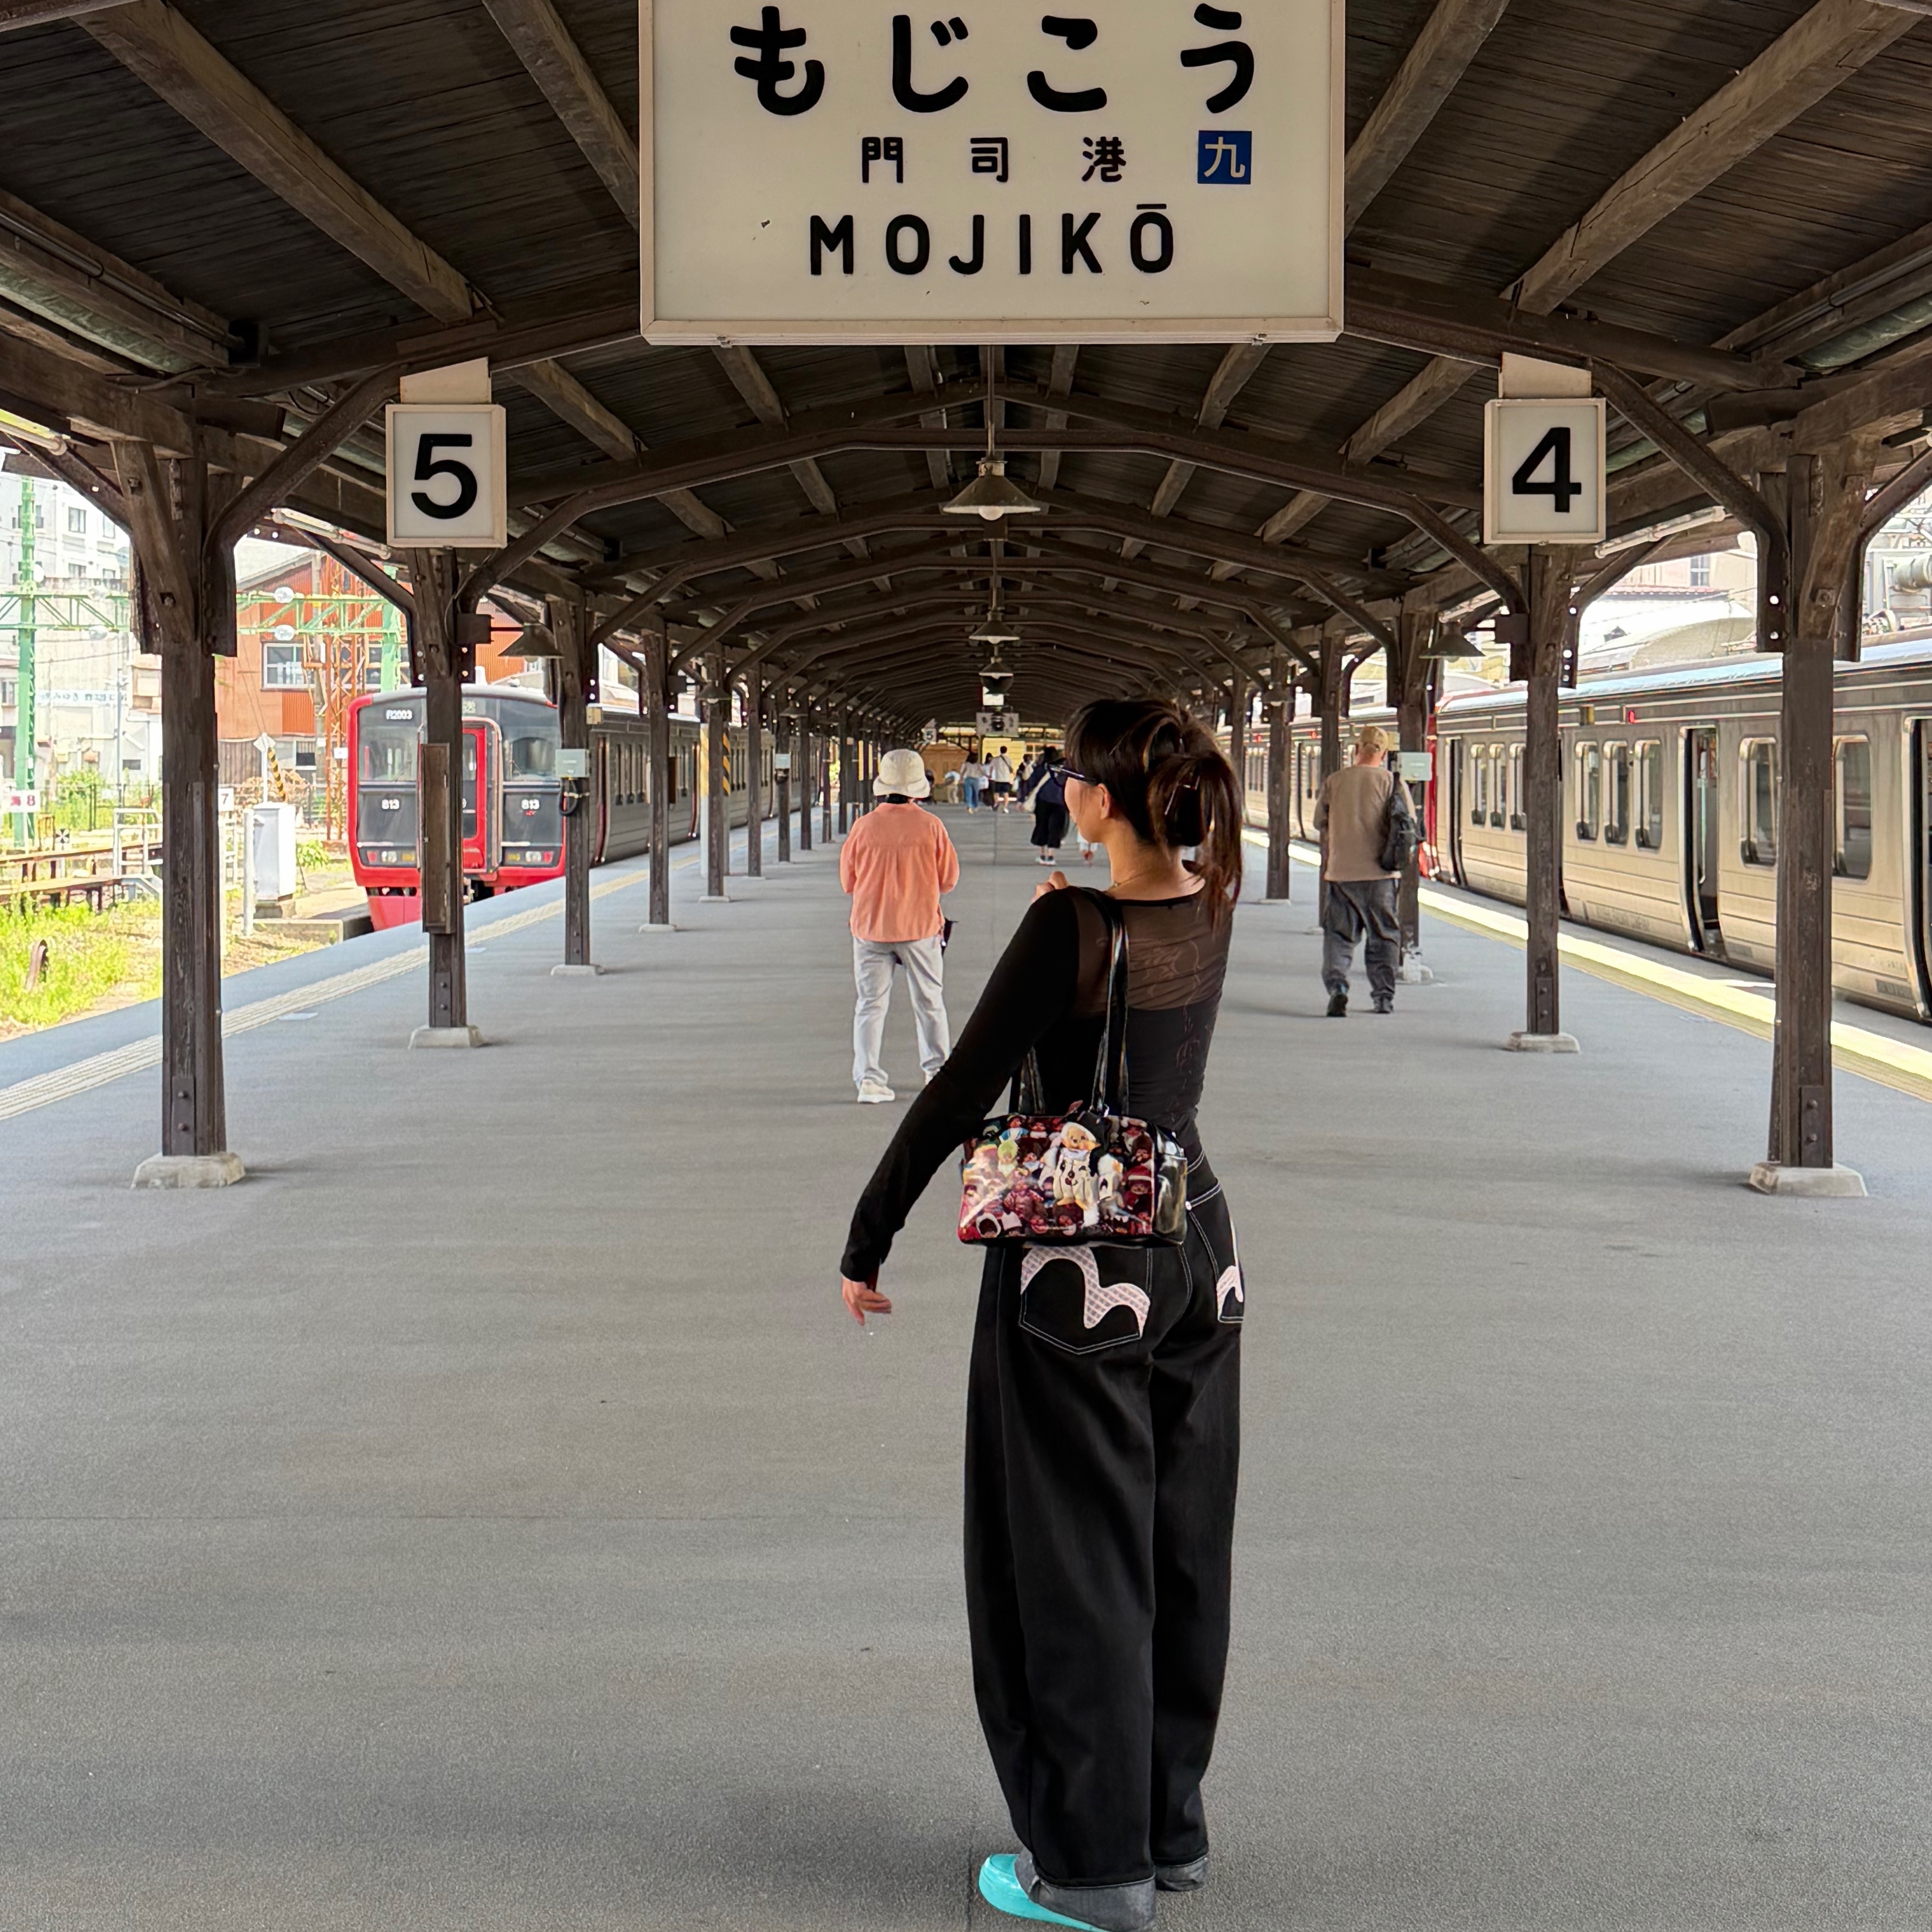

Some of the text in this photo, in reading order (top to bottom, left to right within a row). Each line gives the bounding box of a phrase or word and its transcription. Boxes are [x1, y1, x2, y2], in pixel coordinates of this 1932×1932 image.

[730, 3, 1254, 116] もじこう
[862, 136, 1127, 183] 門司港
[1204, 136, 1245, 178] 九
[810, 203, 1174, 275] MOJIKŌ
[411, 433, 477, 520] 5
[1512, 426, 1582, 513] 4
